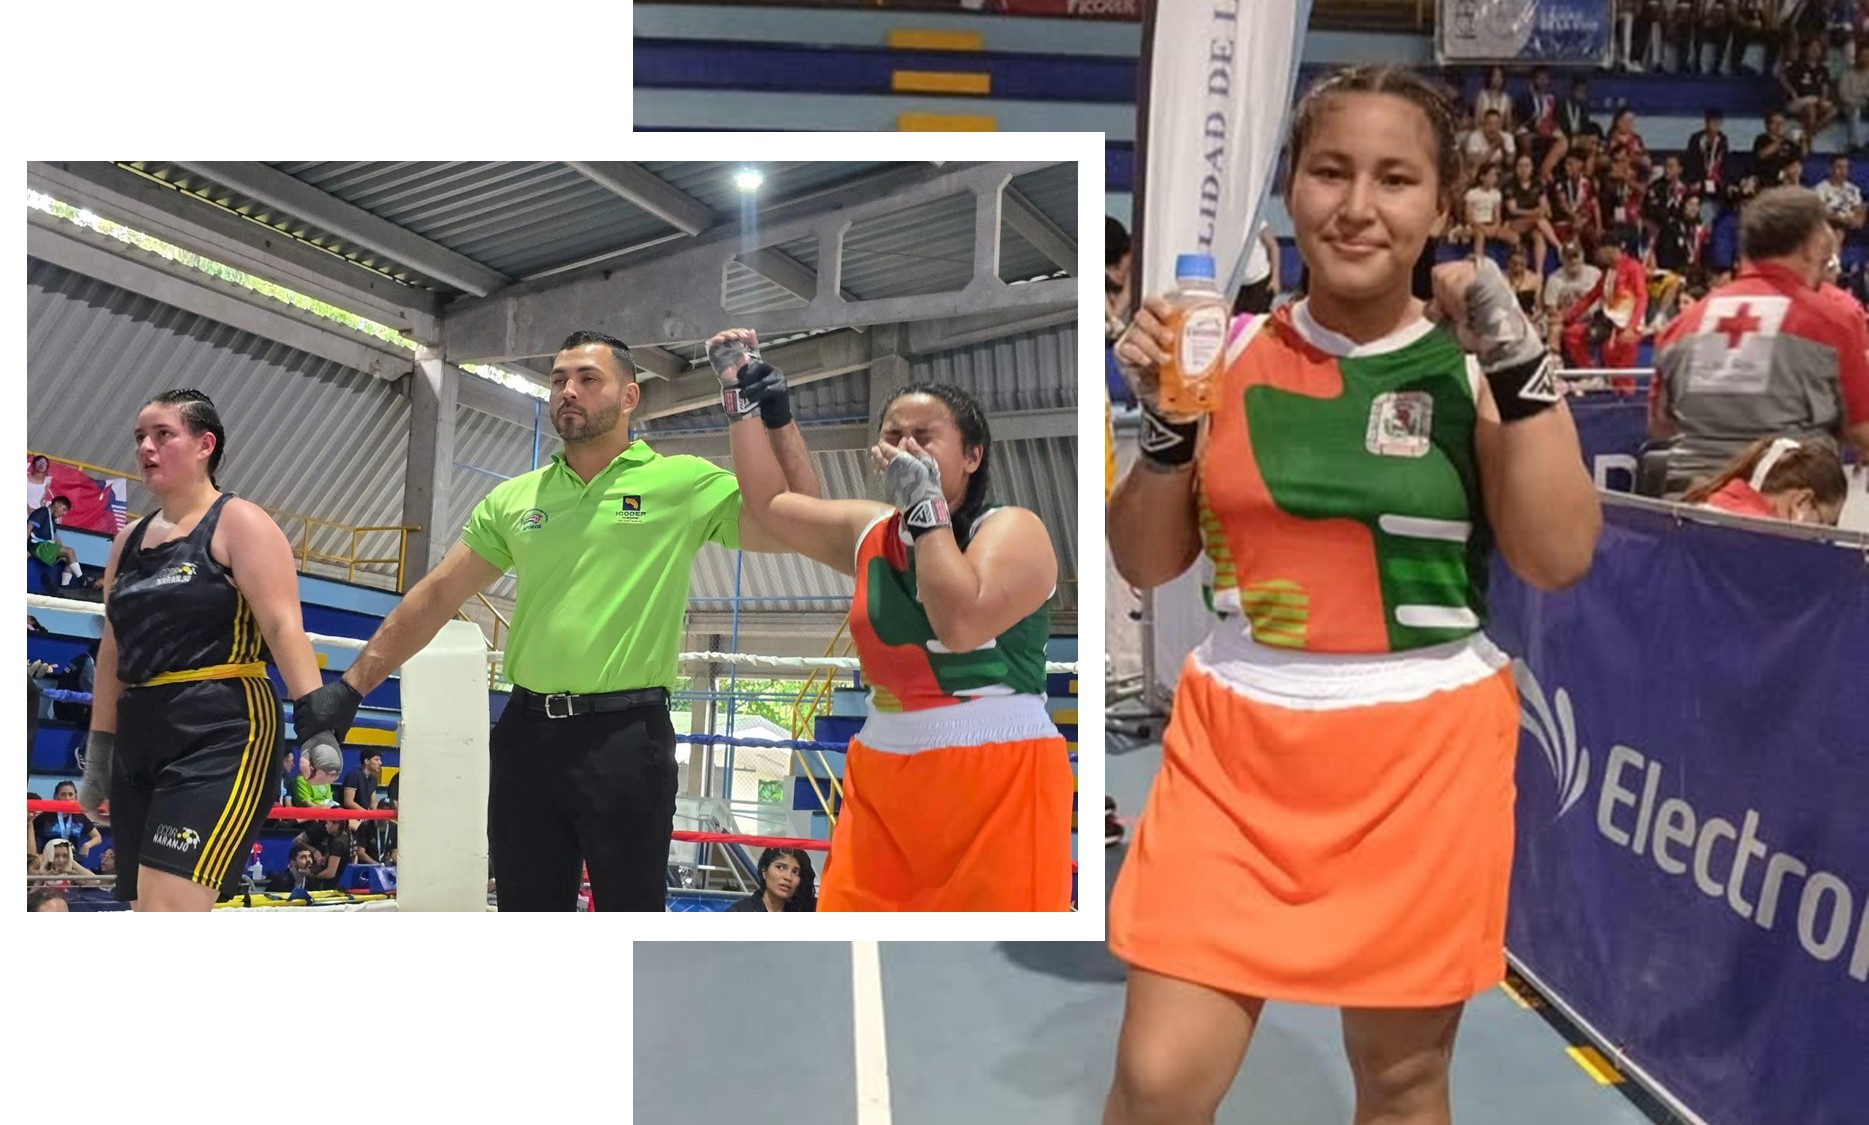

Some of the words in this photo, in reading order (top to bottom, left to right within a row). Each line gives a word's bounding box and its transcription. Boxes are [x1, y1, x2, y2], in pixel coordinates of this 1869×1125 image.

[1208, 39, 1235, 98] DE
[1198, 111, 1226, 250] LIDAD
[156, 575, 191, 585] NARANJO
[153, 834, 188, 852] NARANJO
